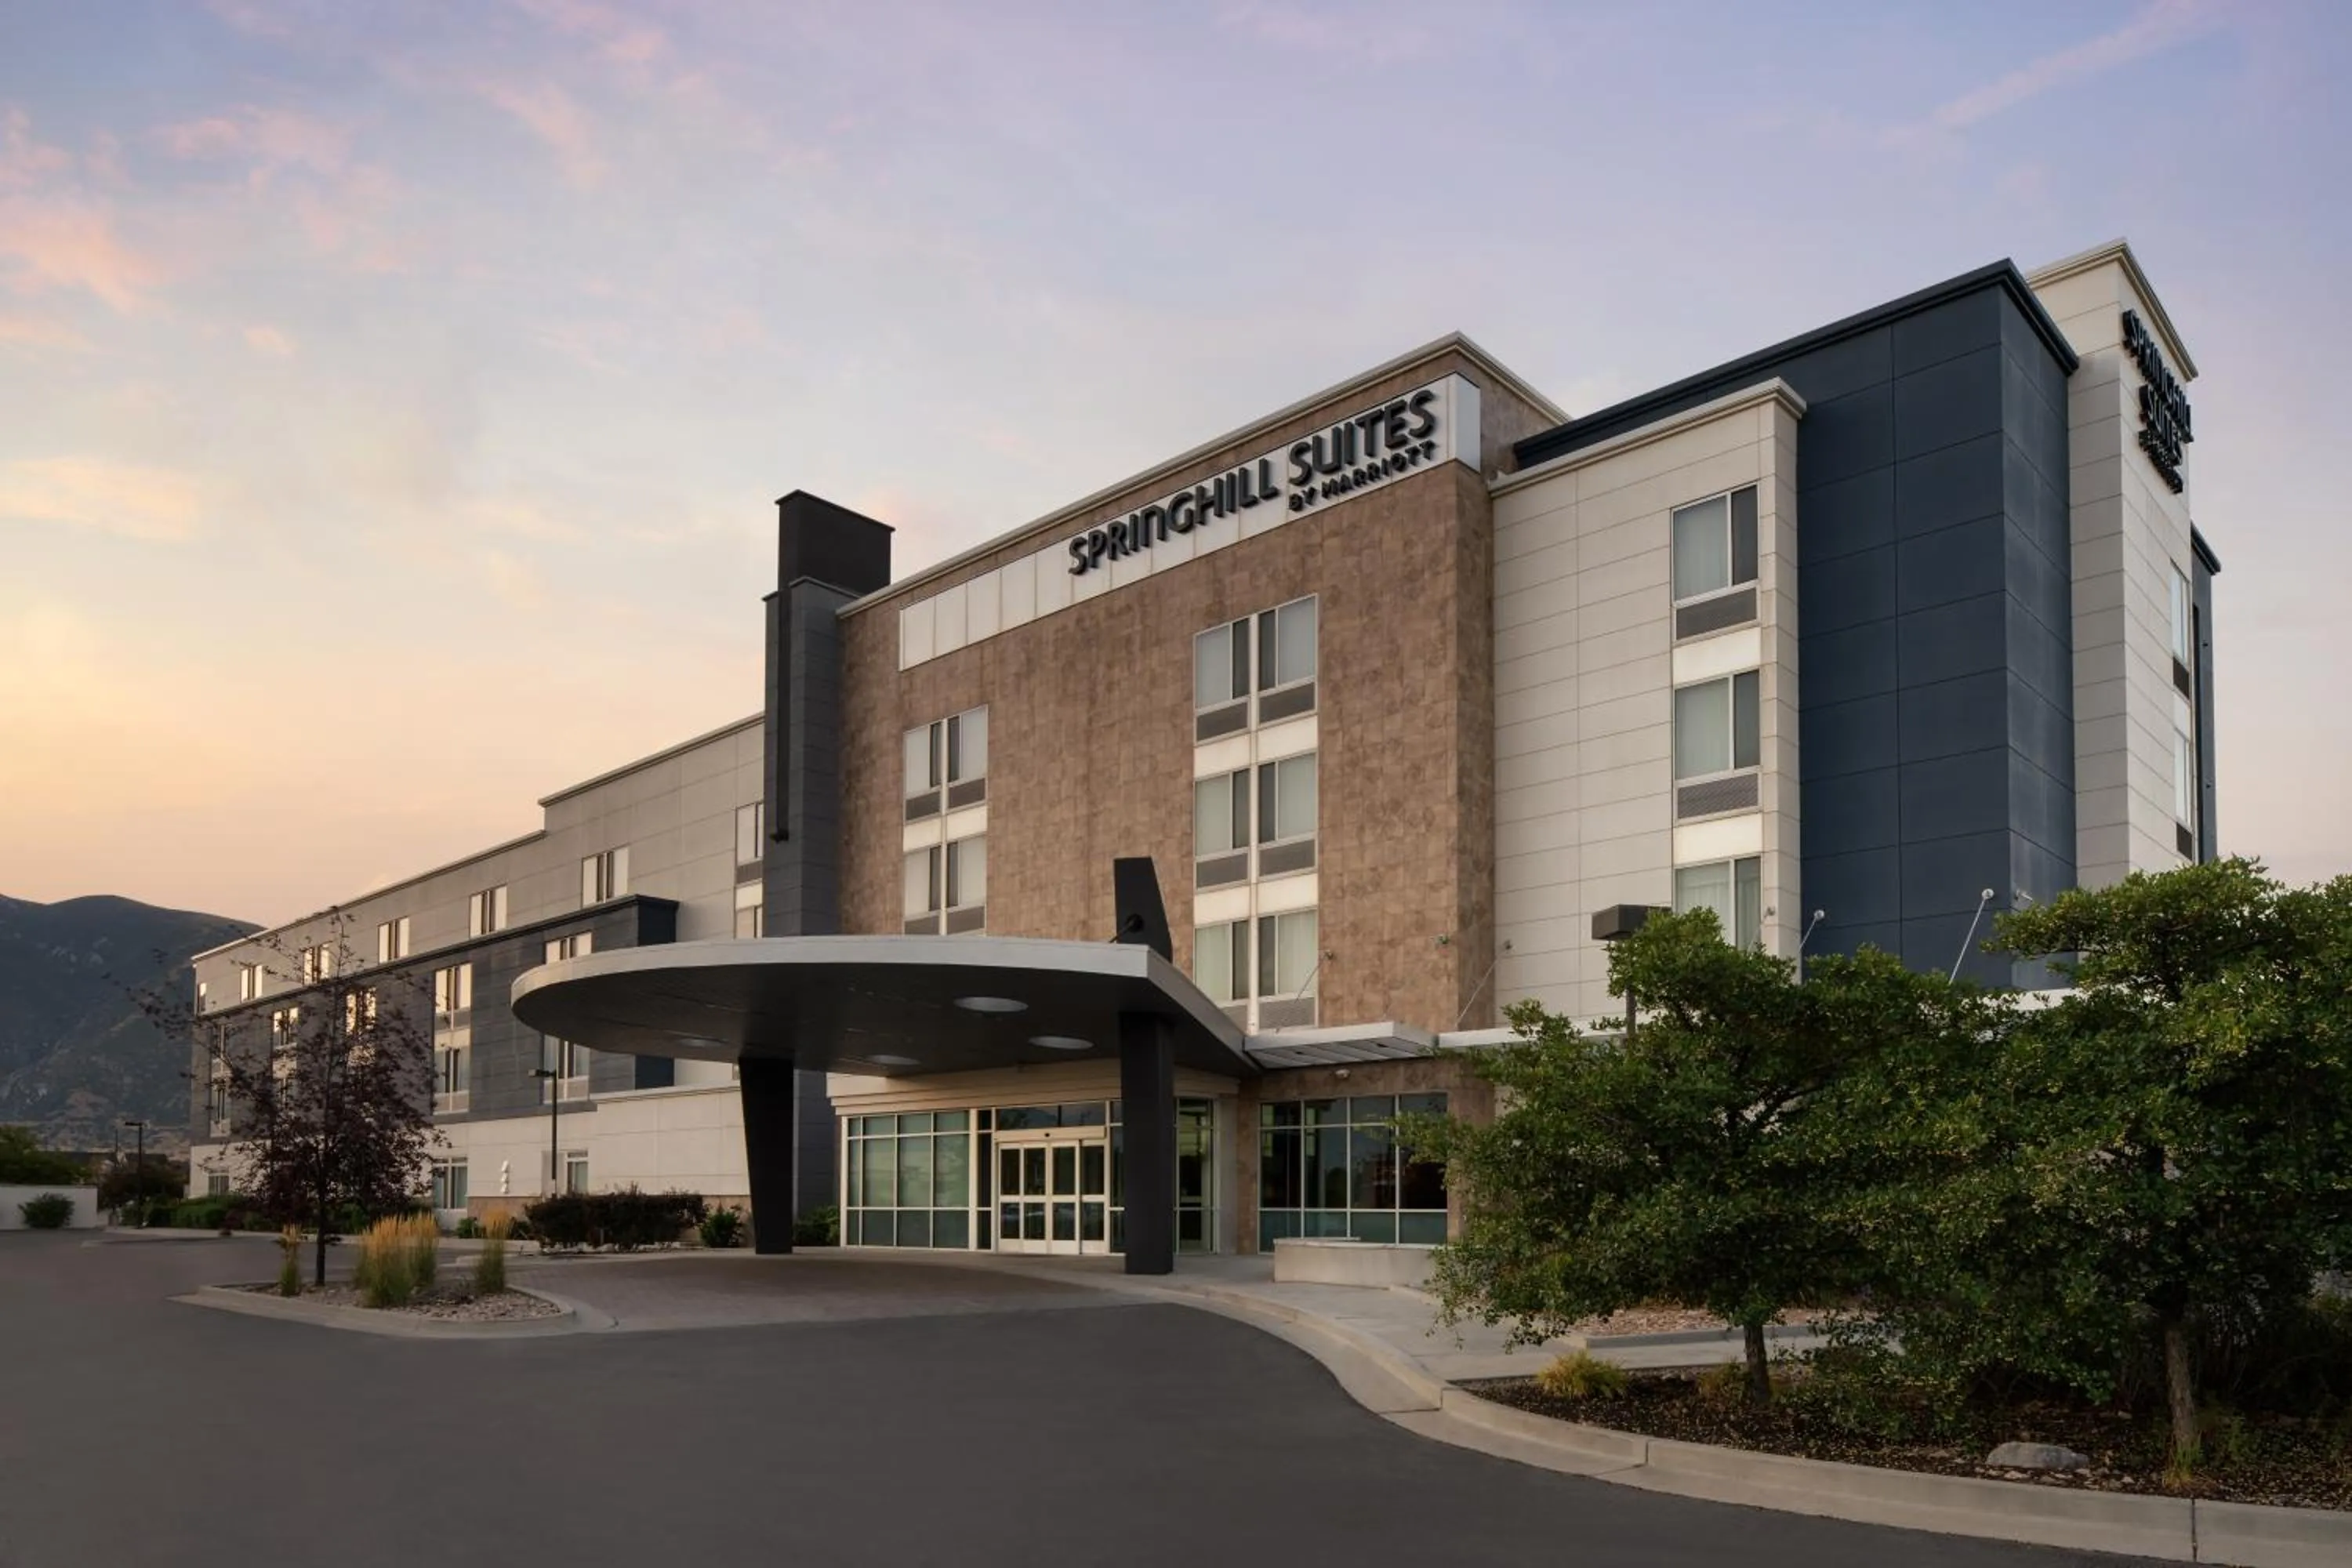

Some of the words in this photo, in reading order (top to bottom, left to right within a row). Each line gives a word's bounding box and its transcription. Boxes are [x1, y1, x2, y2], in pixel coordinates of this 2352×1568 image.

[1068, 458, 1279, 575] SPRINGHILL
[1288, 390, 1436, 486] SUITES
[1289, 486, 1317, 511] BY
[1322, 439, 1436, 499] MARRIOTT
